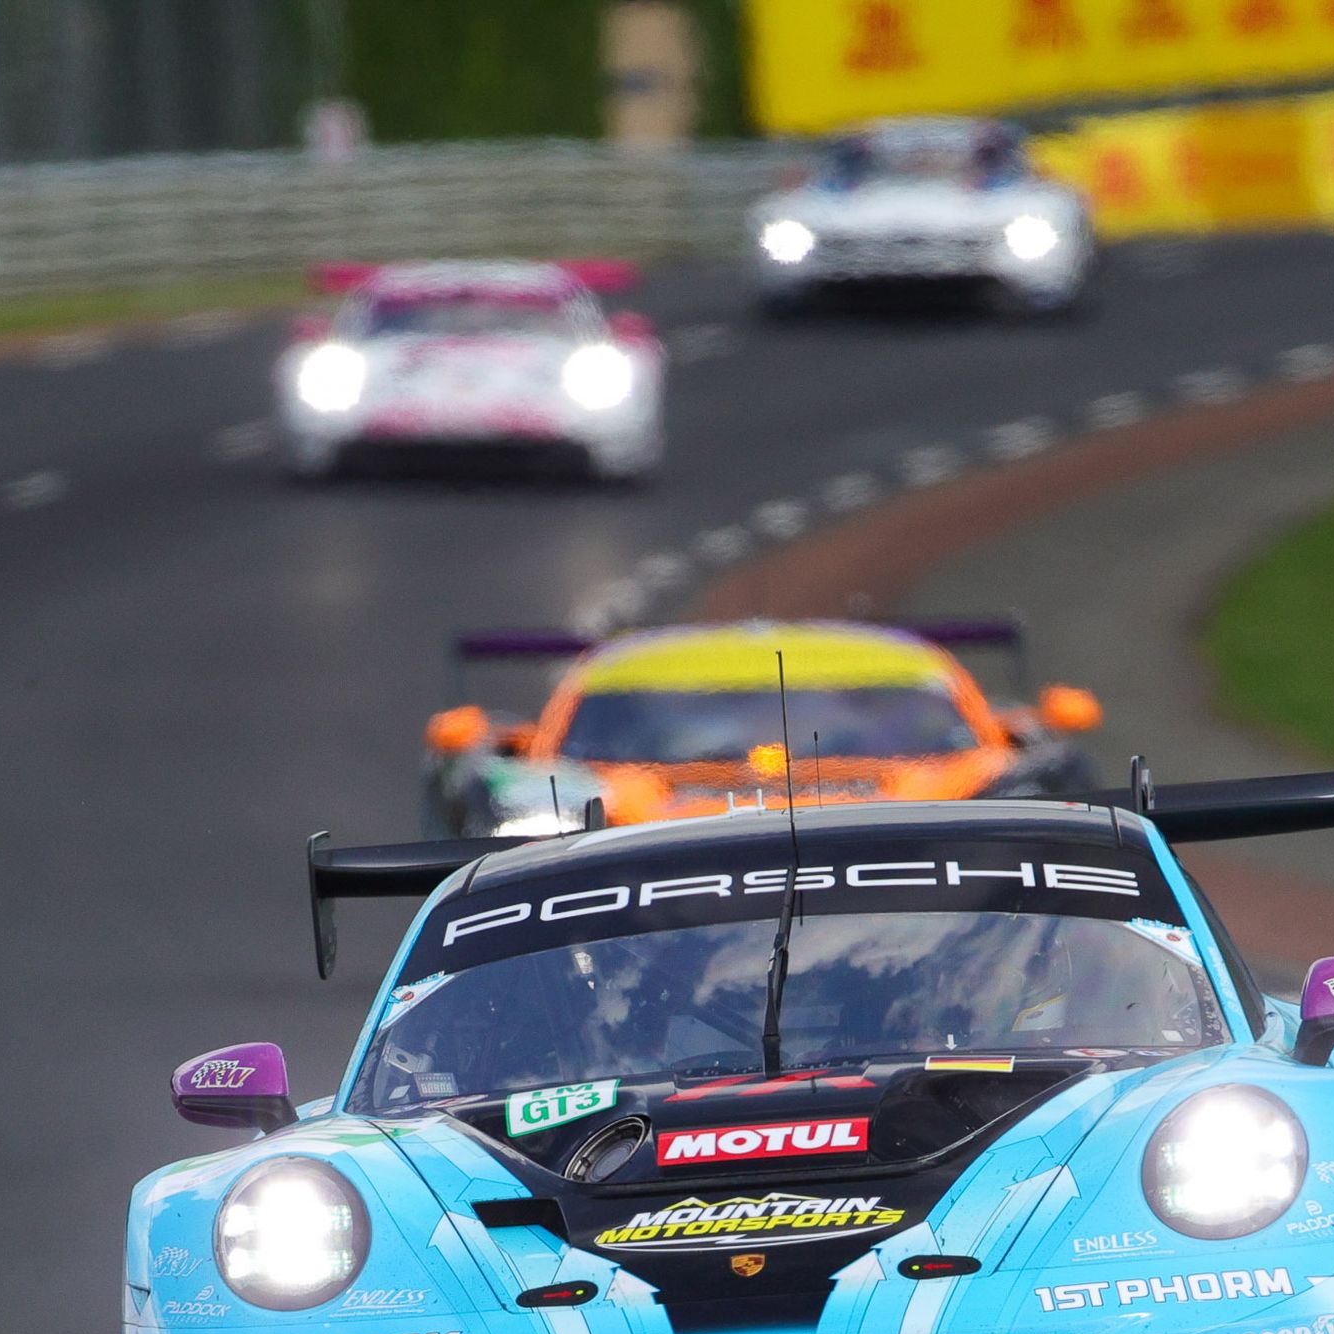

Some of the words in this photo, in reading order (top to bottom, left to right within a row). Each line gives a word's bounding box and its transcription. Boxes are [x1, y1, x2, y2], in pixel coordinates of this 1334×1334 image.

[442, 861, 1140, 948] PORSCHE
[196, 1066, 256, 1089] KW
[521, 1090, 602, 1125] GT3
[663, 1122, 860, 1160] MOTUL
[595, 1210, 906, 1245] MOTORSPORTS
[625, 1196, 881, 1229] MOUNTAIN
[1073, 1229, 1159, 1254] ENDLESS
[341, 1288, 432, 1308] ENDLESS
[1035, 1281, 1110, 1312] 1ST
[1115, 1267, 1295, 1306] PHORM
[163, 1300, 232, 1317] PADDOCK
